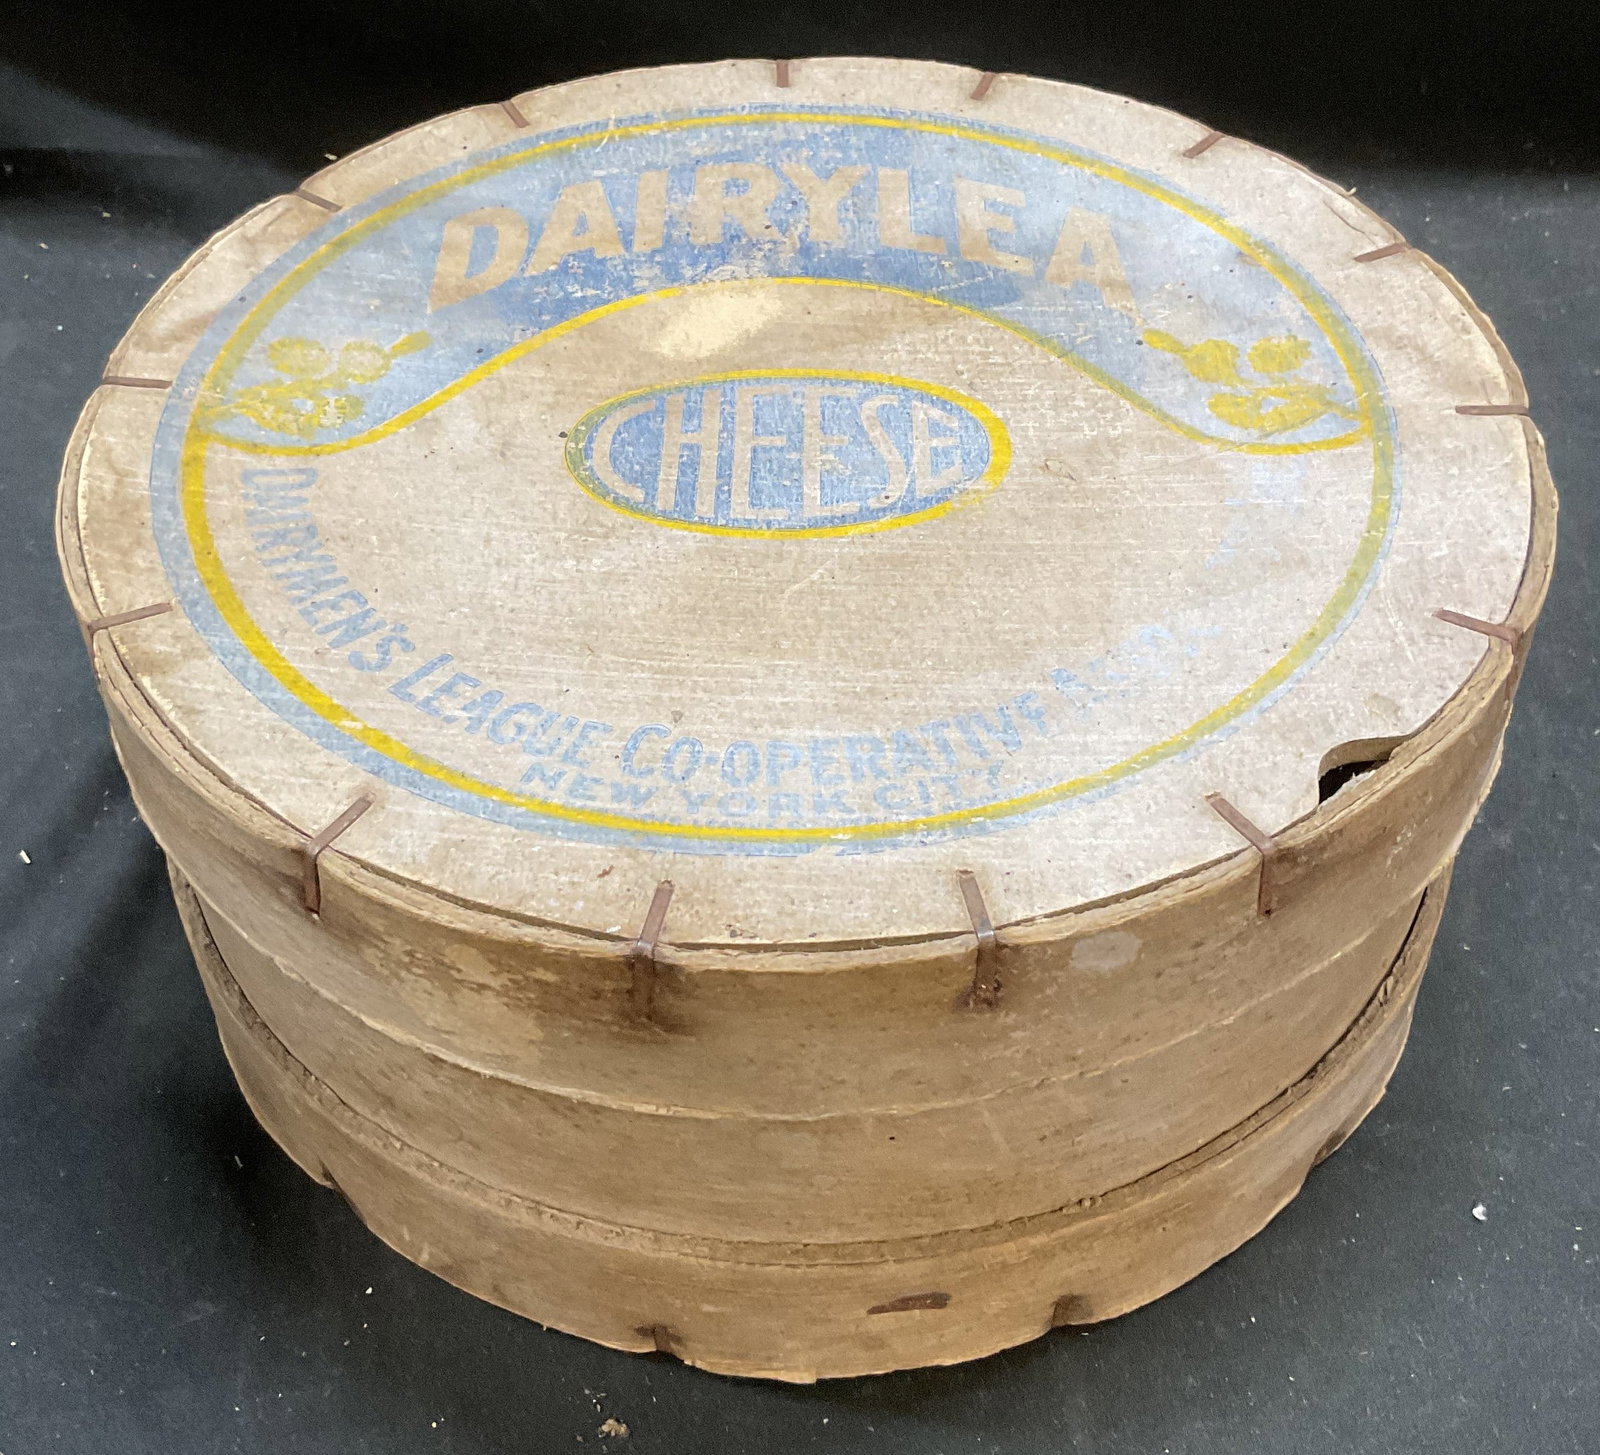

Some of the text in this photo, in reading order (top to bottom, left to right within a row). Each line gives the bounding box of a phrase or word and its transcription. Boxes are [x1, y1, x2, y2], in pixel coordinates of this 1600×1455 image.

[428, 161, 1136, 313] DAIRYLEA
[593, 386, 962, 520] CHEESE
[388, 653, 613, 768] LEAGUE
[620, 691, 1047, 788] CO-OPERATIVE
[519, 762, 657, 807] NEW
[679, 790, 857, 818] YORK
